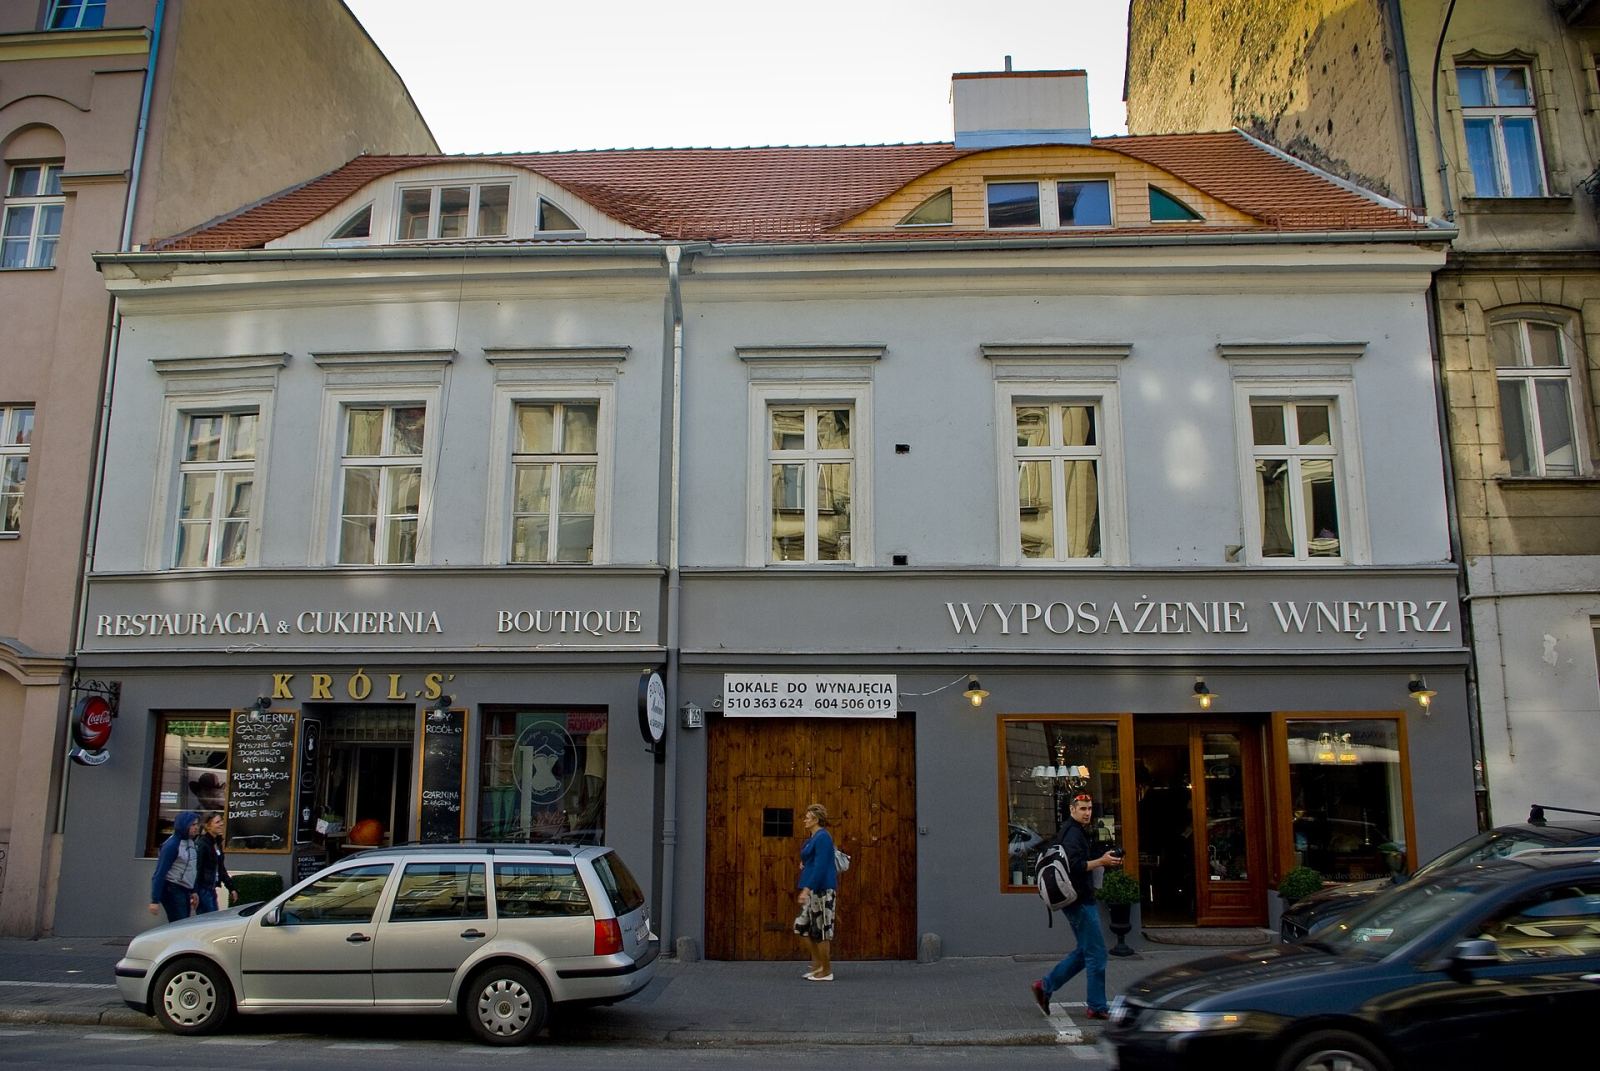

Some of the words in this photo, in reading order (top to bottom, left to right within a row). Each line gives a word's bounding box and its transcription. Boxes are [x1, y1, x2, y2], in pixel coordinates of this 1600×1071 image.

[96, 612, 270, 637] RESTAURACJA
[277, 619, 291, 634] &
[297, 609, 443, 634] CUKIERNIA
[497, 609, 642, 636] BOUTIQUE
[945, 594, 1248, 635] WYPOSAŻENIE
[1270, 599, 1451, 640] WNĘTRZ
[728, 682, 779, 693] LOKALE
[787, 682, 808, 693] DO
[816, 682, 893, 697] WYNAJĘCIA
[727, 698, 751, 709] 510
[753, 698, 776, 709] 363
[779, 698, 804, 709] 624
[814, 698, 838, 709] 604
[841, 698, 865, 709] 506
[867, 698, 891, 709] 019
